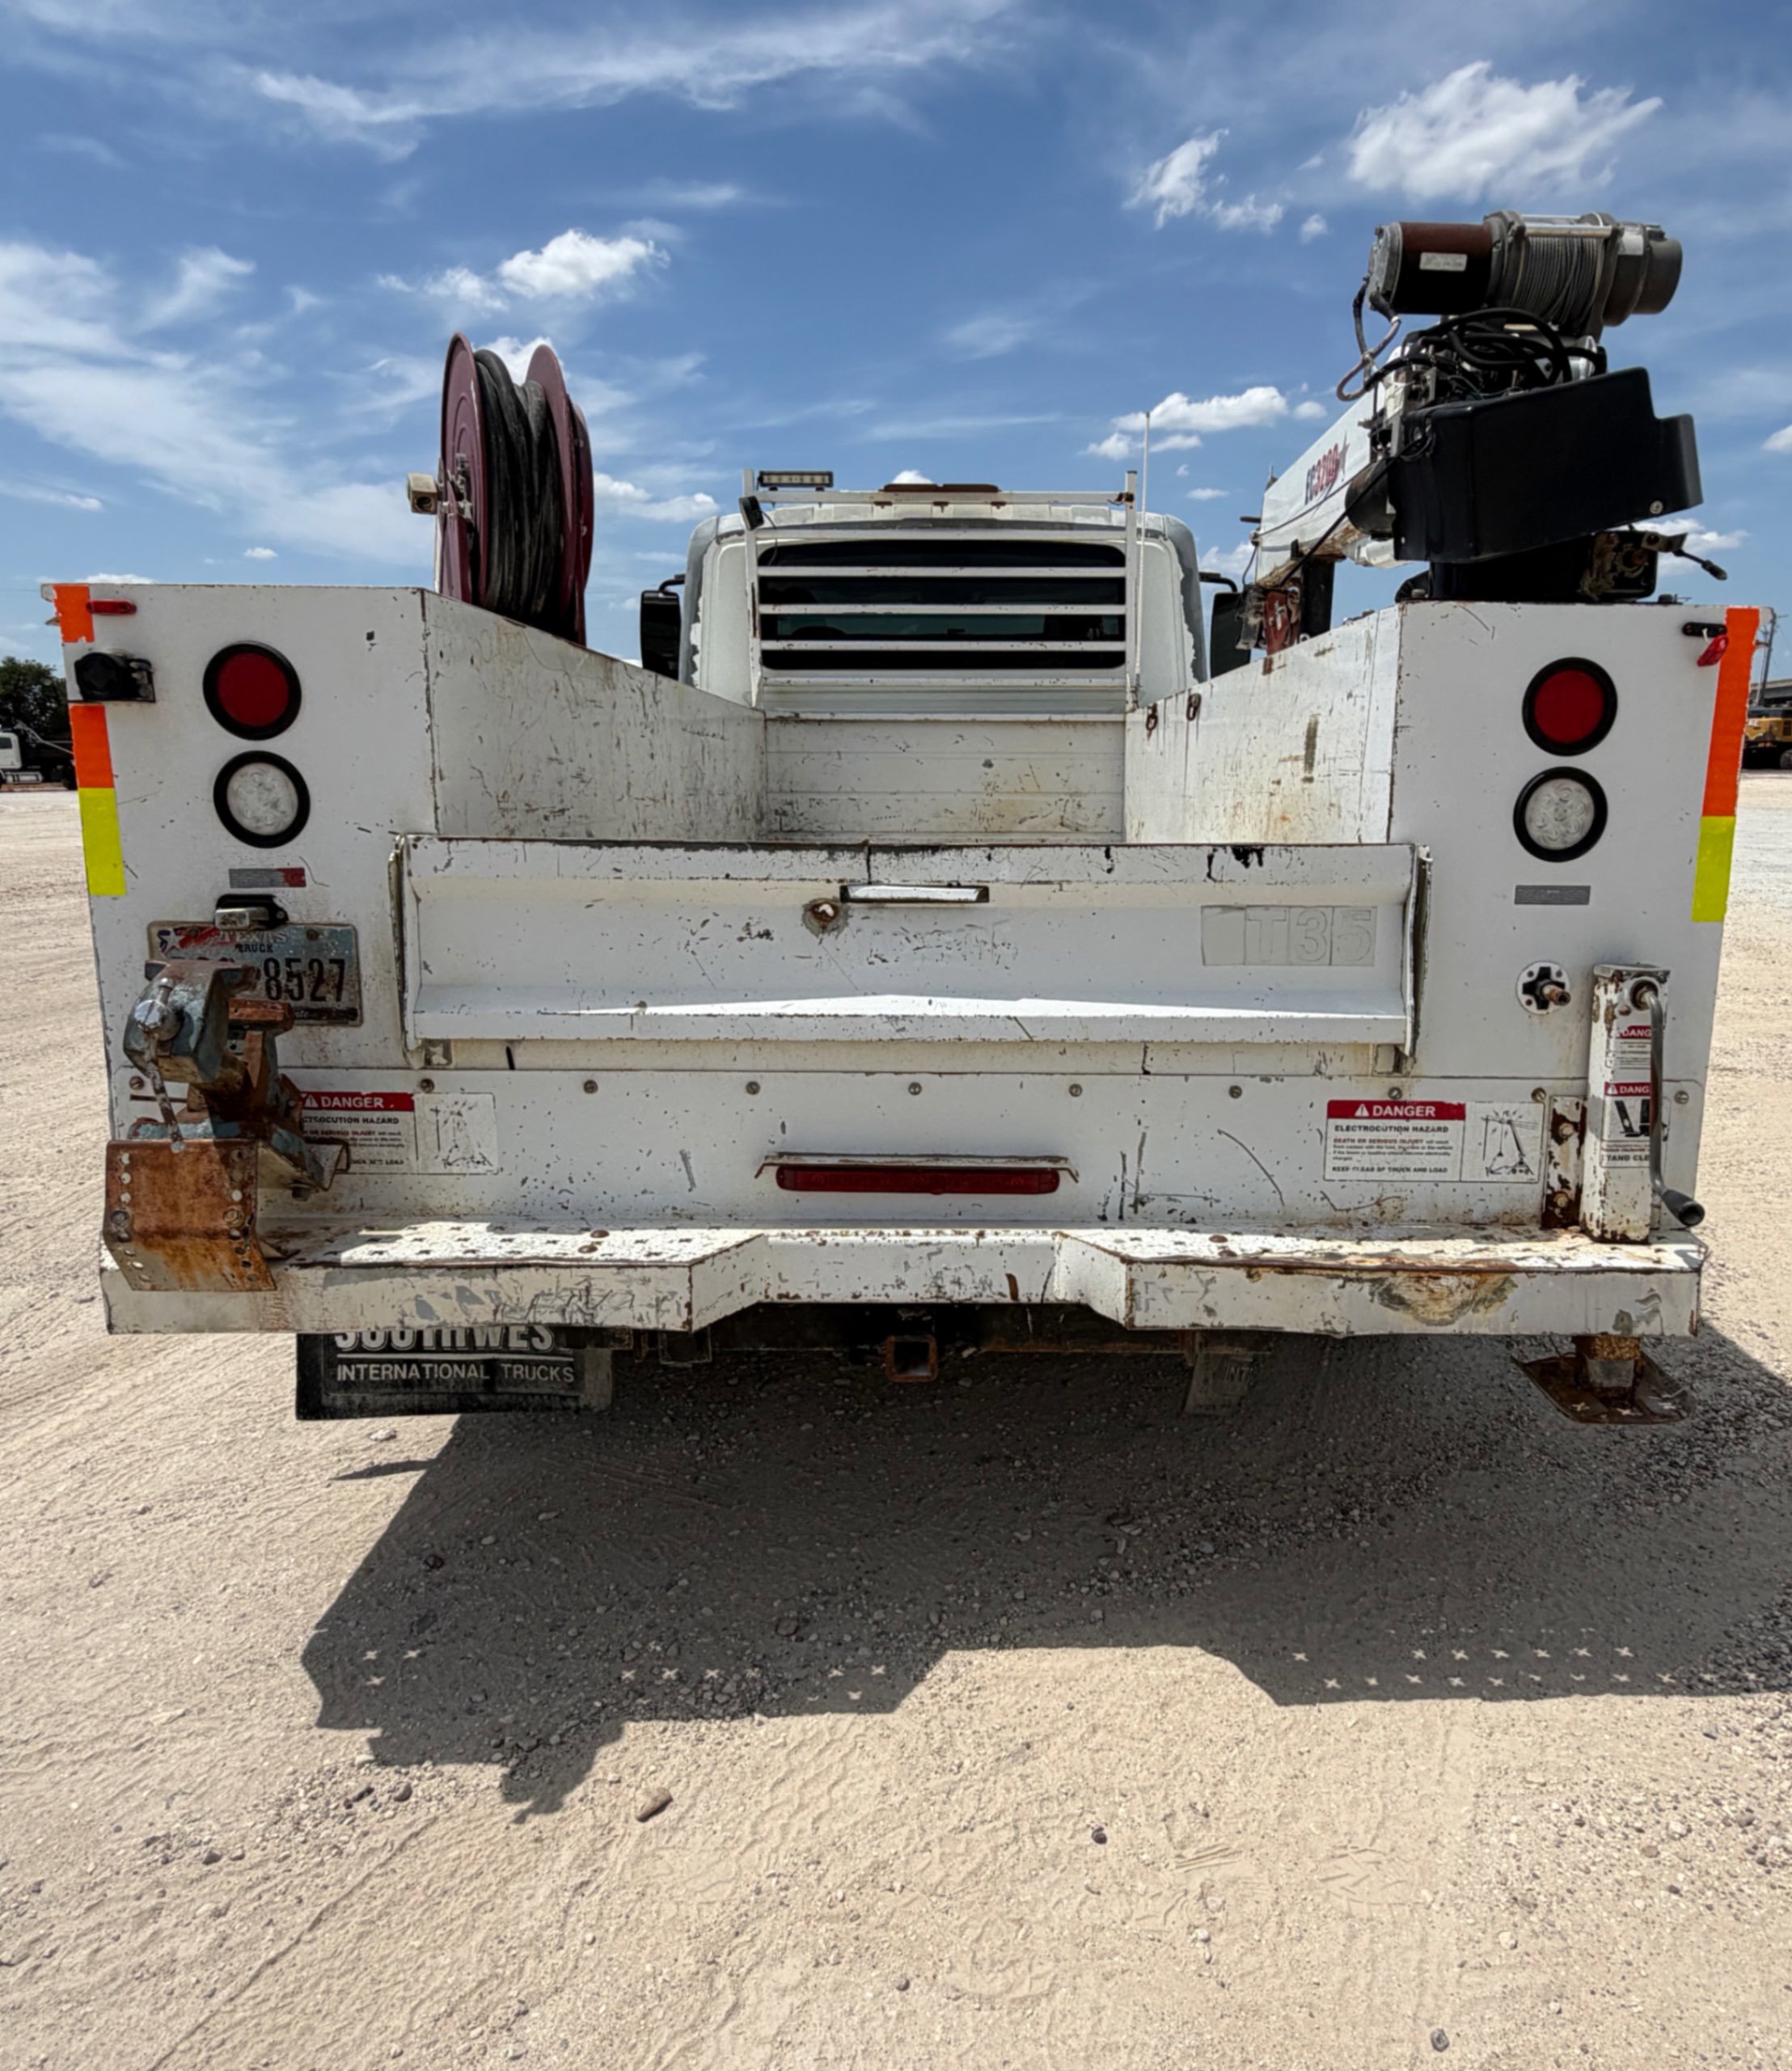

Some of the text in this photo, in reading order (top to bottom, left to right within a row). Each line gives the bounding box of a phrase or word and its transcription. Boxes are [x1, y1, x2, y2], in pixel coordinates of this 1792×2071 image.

[263, 957, 346, 1003] 8527
[1621, 1029, 1650, 1037] DANG
[1619, 1085, 1650, 1094] DANG
[320, 1096, 384, 1109] DANGER
[1372, 1105, 1436, 1118] DANGER
[1334, 1124, 1449, 1134] ELECTROCUTION HAZARD
[335, 1325, 560, 1352] SOUTHWES
[336, 1363, 575, 1383] INTERNATIONAL TRUCKS
